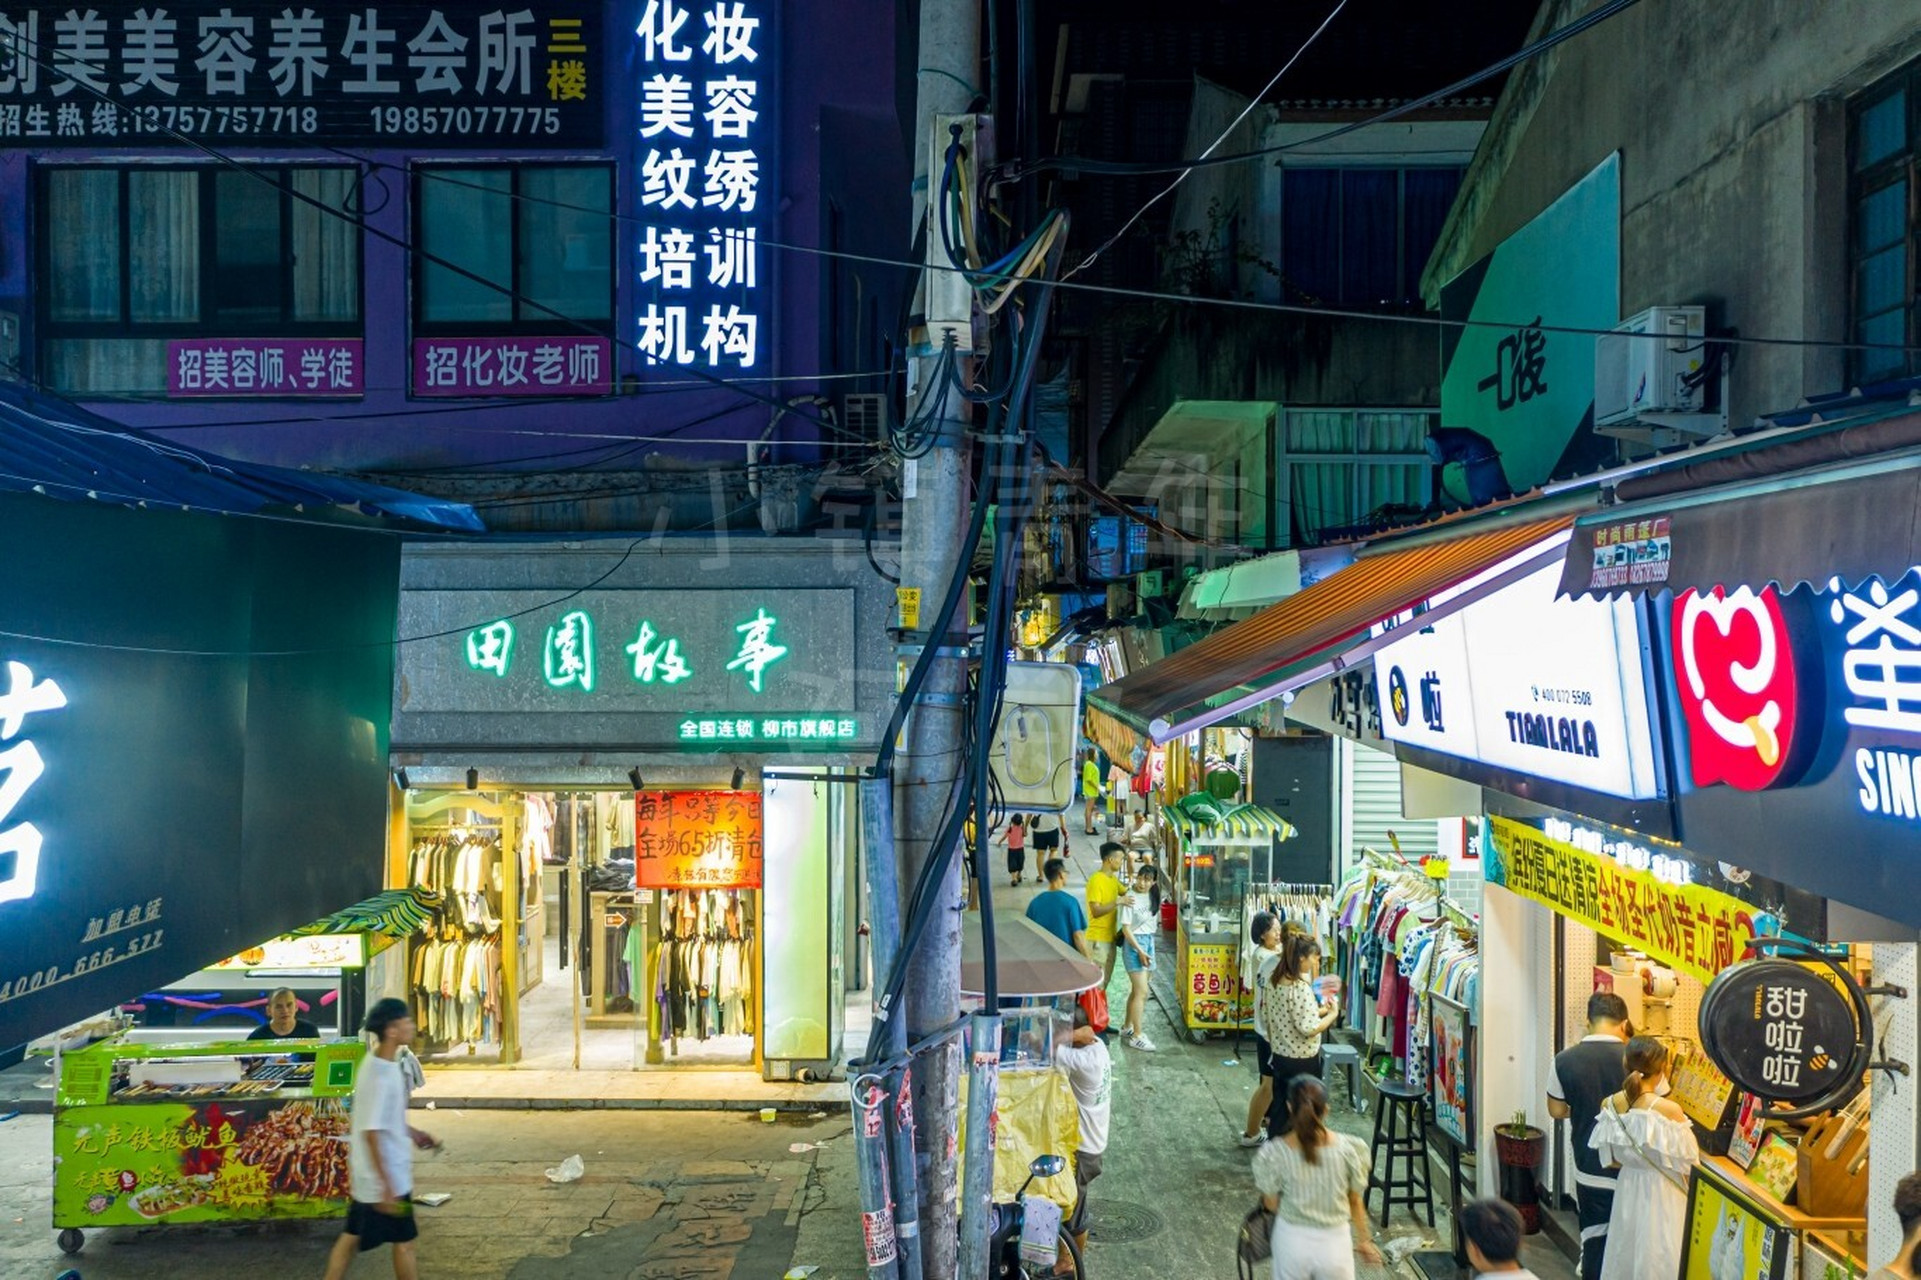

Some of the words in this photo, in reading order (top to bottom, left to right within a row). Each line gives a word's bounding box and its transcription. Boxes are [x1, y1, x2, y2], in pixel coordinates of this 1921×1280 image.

[547, 19, 587, 101] 三楼
[636, 0, 760, 63] 化妆
[370, 107, 561, 135] 19857077775
[640, 73, 759, 138] 美容
[640, 147, 760, 212] 纹绣
[639, 226, 757, 289] 培训
[426, 344, 600, 387] 招化妆老师
[637, 303, 758, 367] 机构
[178, 347, 353, 389] 招美容师、学徒
[680, 720, 755, 738] 全国连锁
[762, 720, 856, 738] 柳市旗舰店
[1856, 747, 1921, 819] SIN
[1763, 986, 1808, 1087] 甜啦啦
